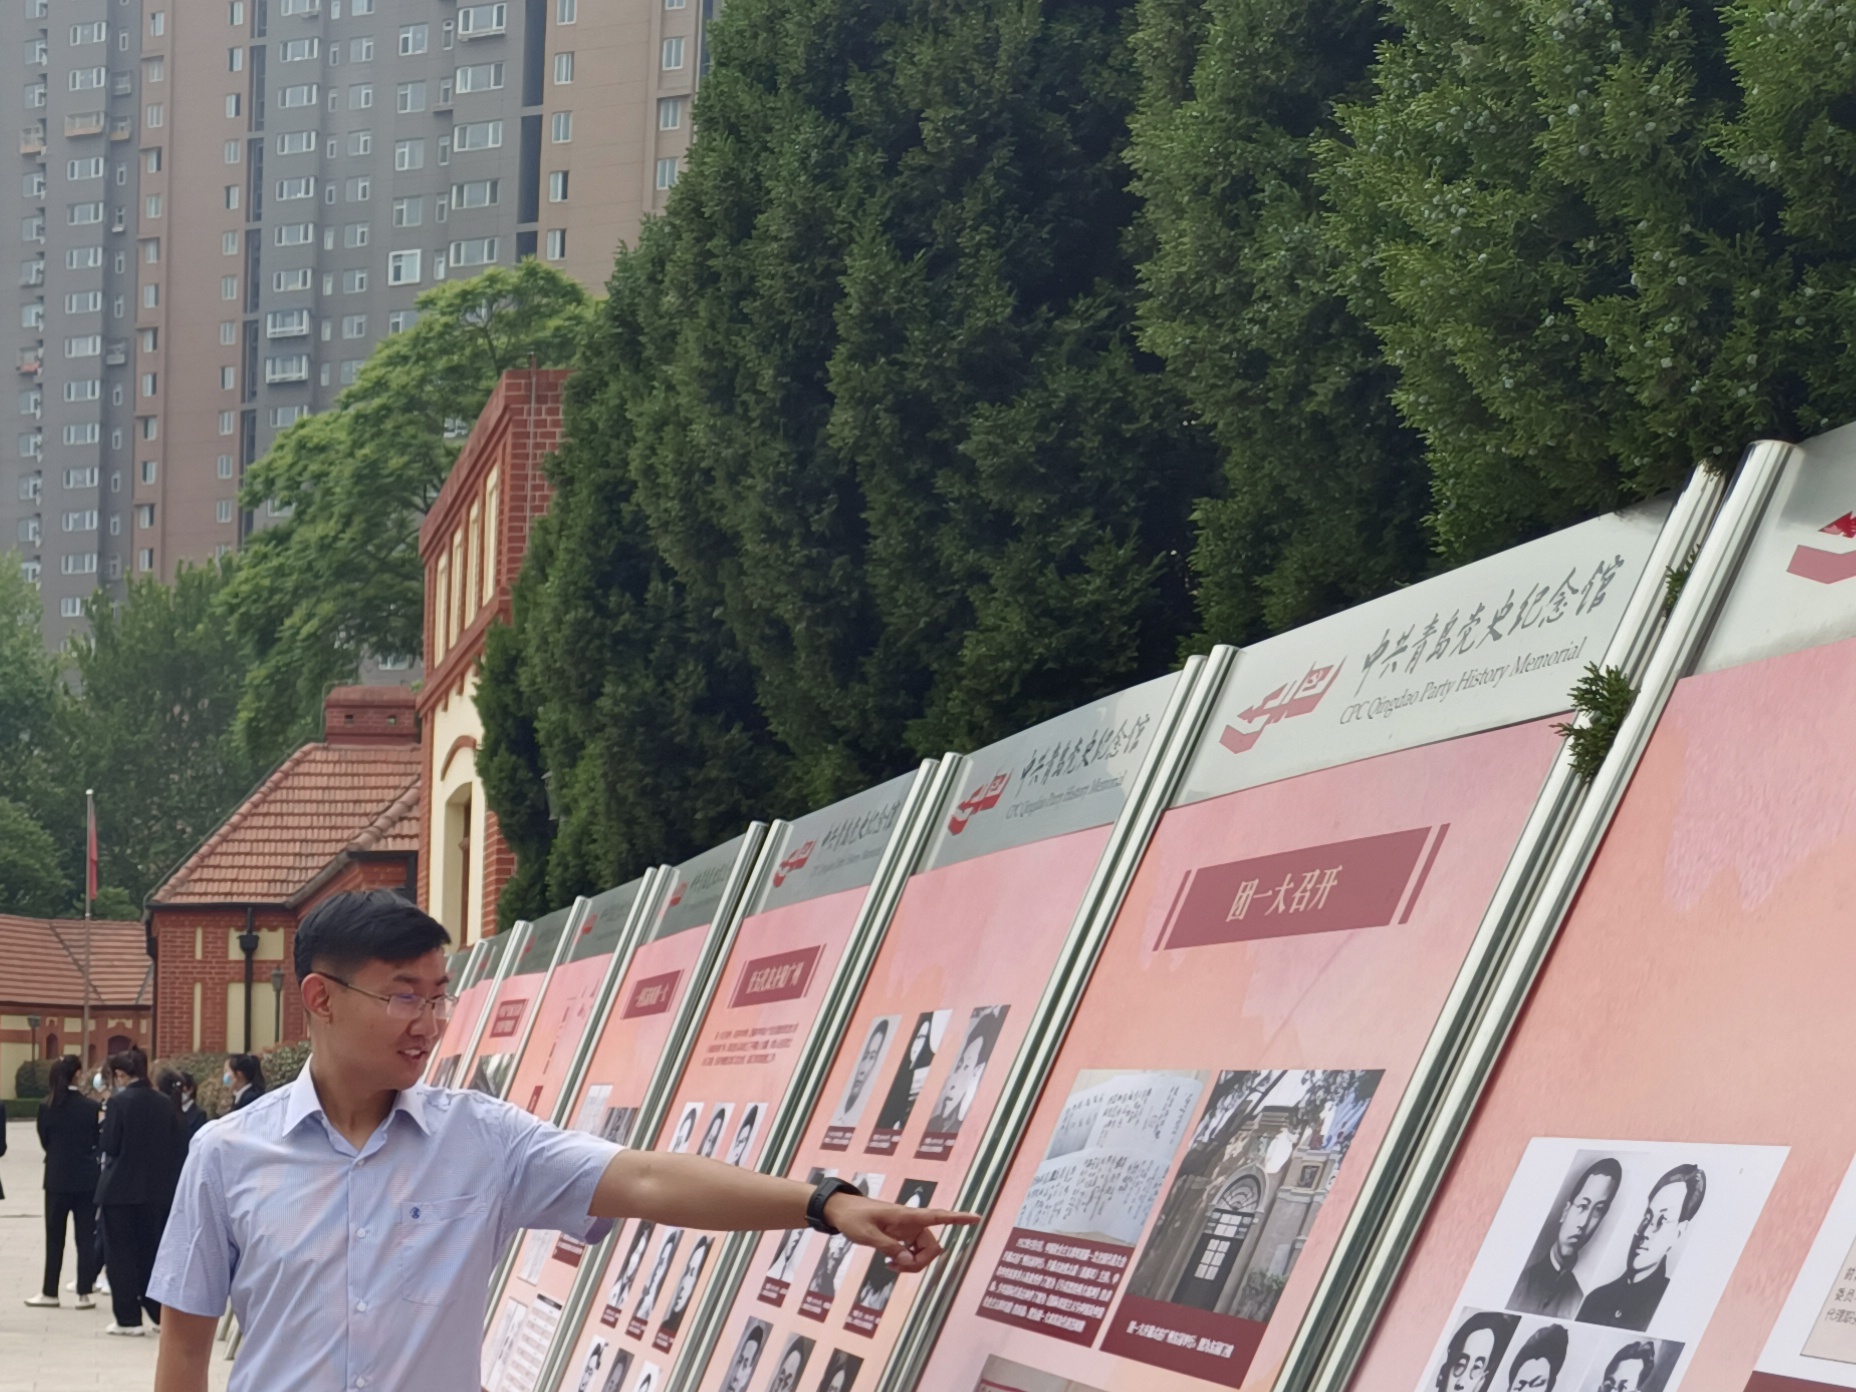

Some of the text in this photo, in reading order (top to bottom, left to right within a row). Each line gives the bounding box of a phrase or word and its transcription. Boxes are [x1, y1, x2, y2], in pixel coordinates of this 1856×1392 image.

[1340, 636, 1588, 724] CPC Qingdao Party History Memorial
[1225, 864, 1343, 922] 团一大召开
